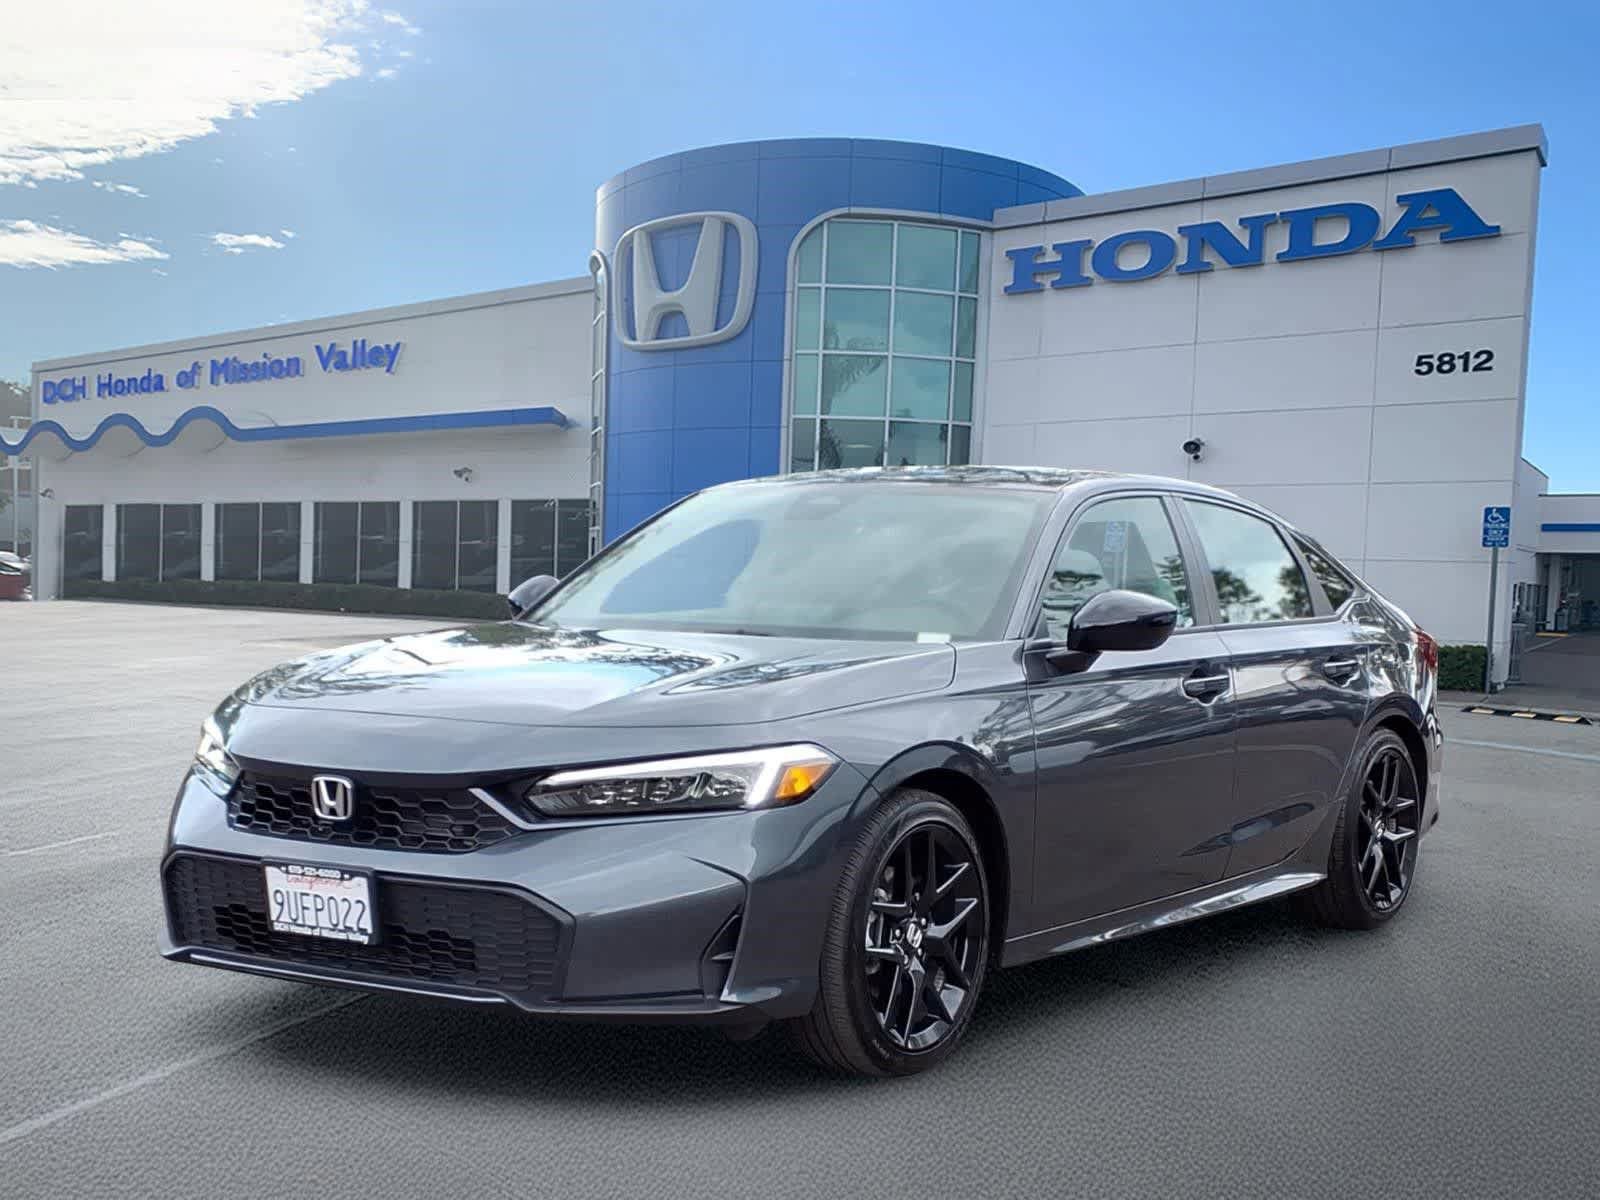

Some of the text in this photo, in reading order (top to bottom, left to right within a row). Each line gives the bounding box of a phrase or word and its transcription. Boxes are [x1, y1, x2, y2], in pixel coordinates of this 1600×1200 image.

[1004, 187, 1501, 295] HONDA
[42, 338, 402, 404] DCH Honda of Mission Valley
[1414, 348, 1494, 376] 5812
[273, 889, 369, 936] 9UFP022
